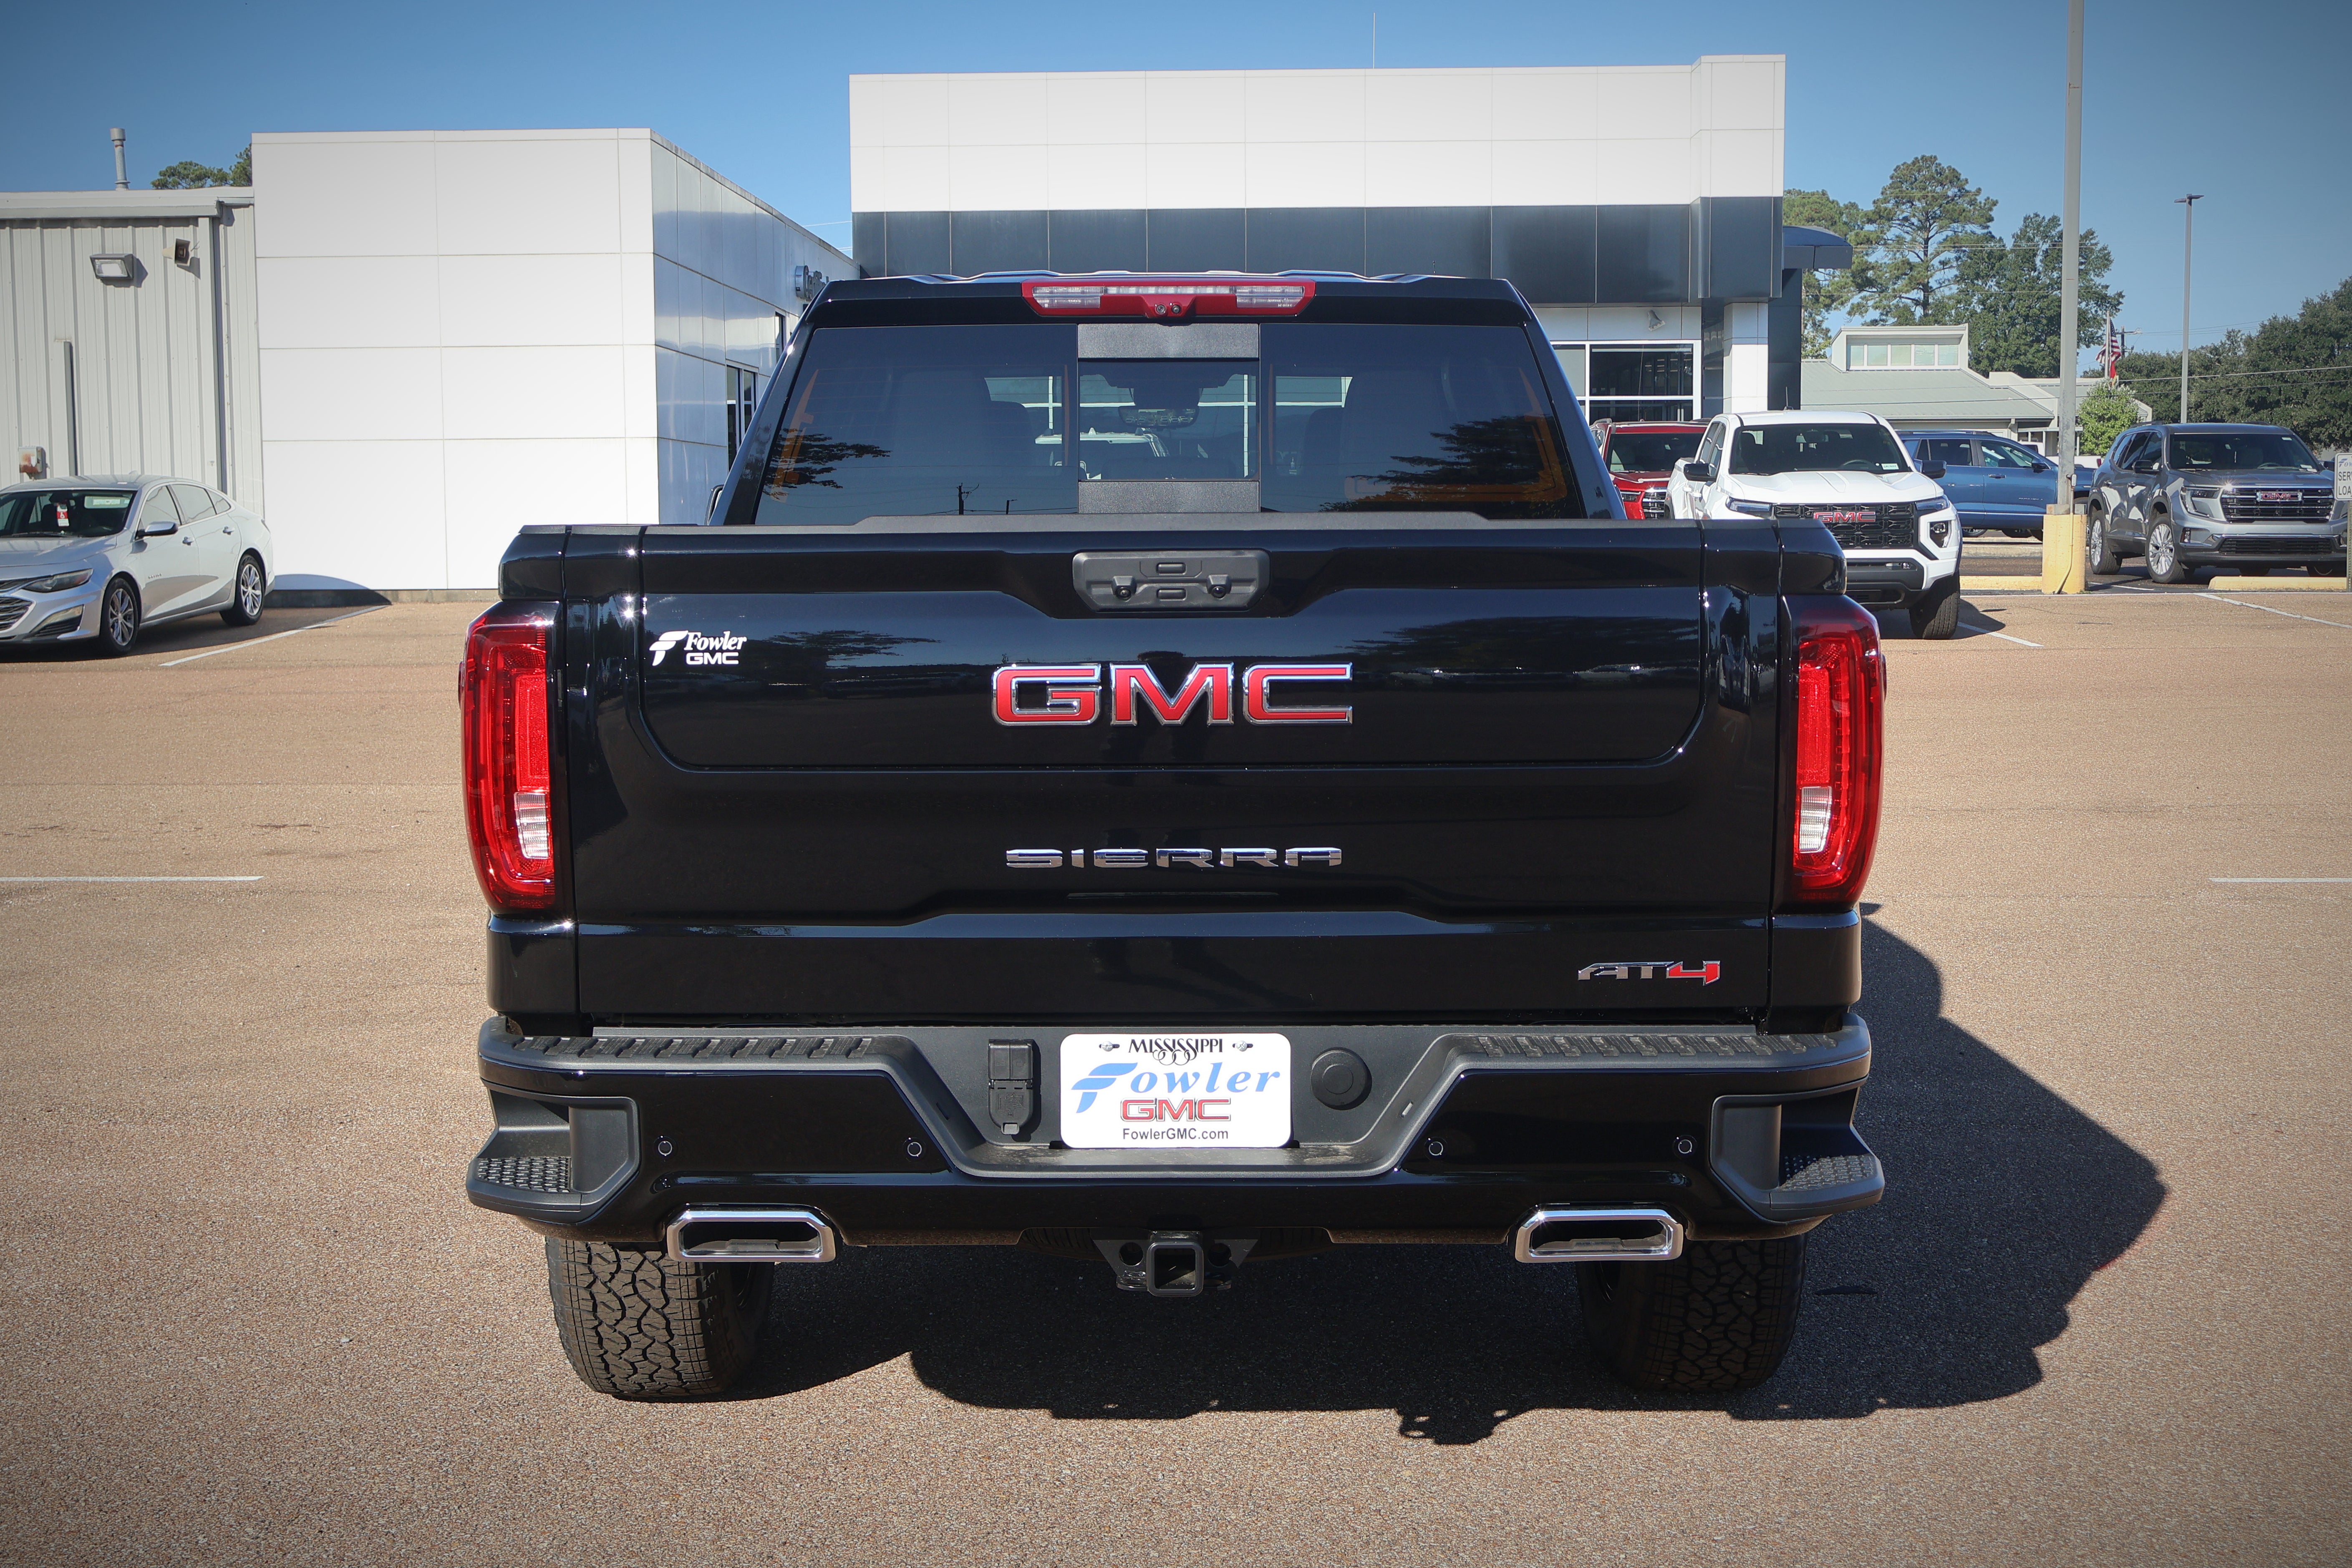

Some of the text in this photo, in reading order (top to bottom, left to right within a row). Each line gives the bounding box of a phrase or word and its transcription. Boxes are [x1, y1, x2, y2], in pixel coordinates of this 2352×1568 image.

[2338, 471, 2352, 481] SER
[1813, 511, 1876, 523] GMC
[683, 631, 747, 650] Fowler
[686, 652, 739, 665] GMC
[991, 662, 1353, 726] GMC
[1006, 847, 1342, 868] SIERRA
[1578, 960, 1720, 986] AT4
[1128, 1038, 1223, 1066] MISSISSIPPI
[1071, 1062, 1280, 1113] Fowler
[1120, 1097, 1231, 1122] GMC
[1123, 1128, 1228, 1140] FowlerGMC.com
